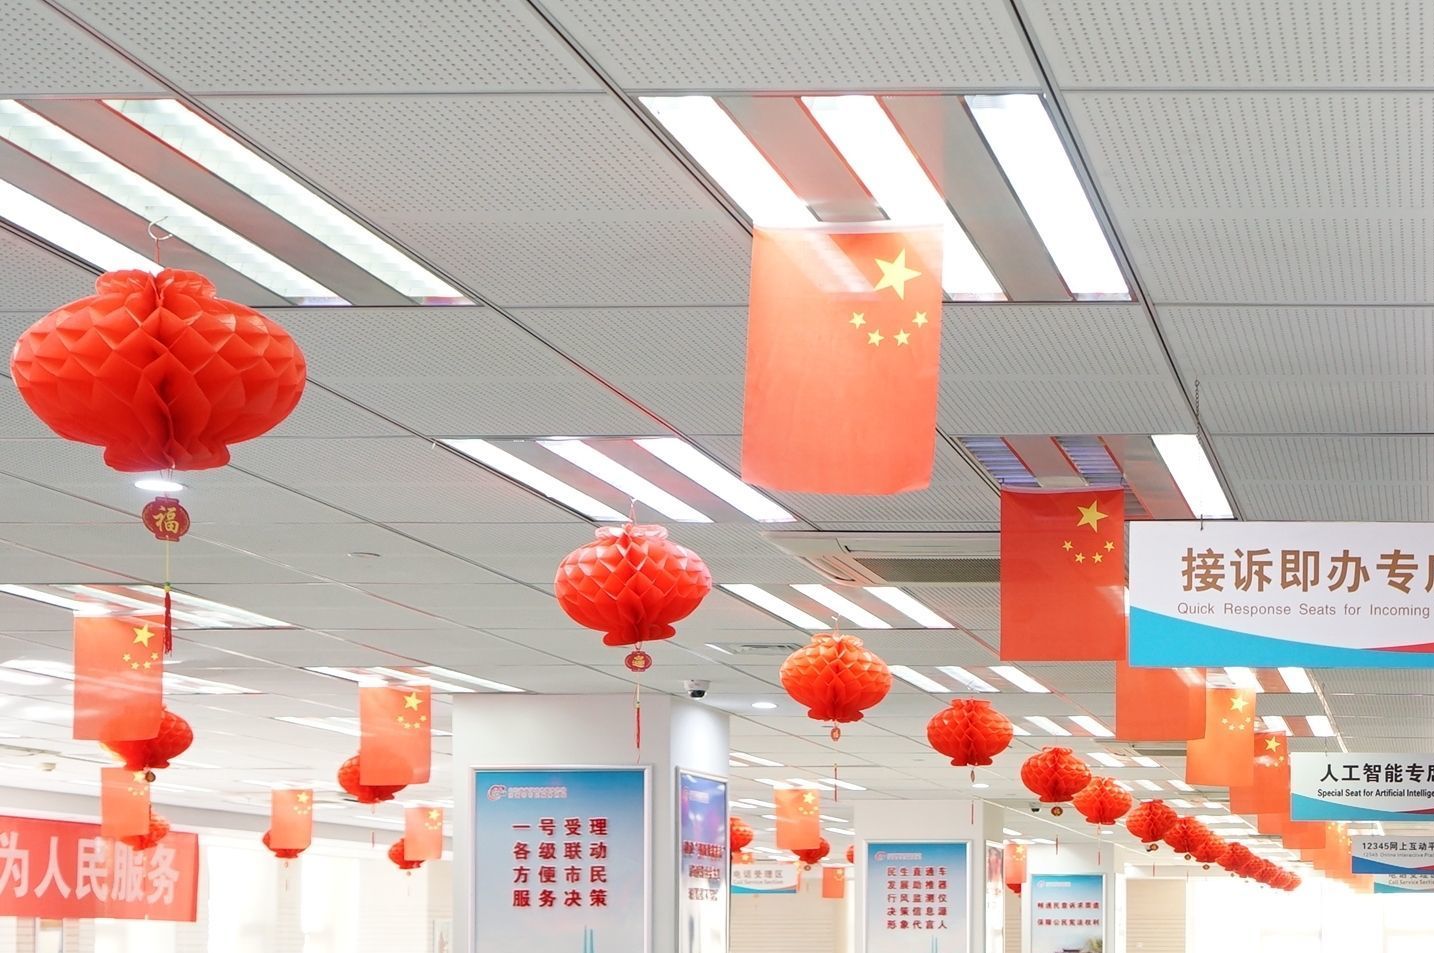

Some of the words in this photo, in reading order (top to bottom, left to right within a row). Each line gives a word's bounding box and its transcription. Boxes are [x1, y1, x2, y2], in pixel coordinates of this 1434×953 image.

[151, 505, 180, 534] 福
[1177, 602, 1215, 616] Quick
[1223, 602, 1291, 618] Response
[1299, 603, 1336, 616] Seats
[1344, 603, 1361, 616] for
[1369, 604, 1431, 620] Incoming
[1317, 788, 1344, 798] Special
[1345, 788, 1362, 797] Seat
[1363, 788, 1374, 797] for
[1375, 788, 1406, 798] Artificial
[512, 818, 609, 836] 一号受理
[512, 842, 609, 860] 各级联动
[0, 831, 180, 905] 为人民服务
[512, 865, 609, 884] 方便市民
[512, 889, 609, 908] 服务决策
